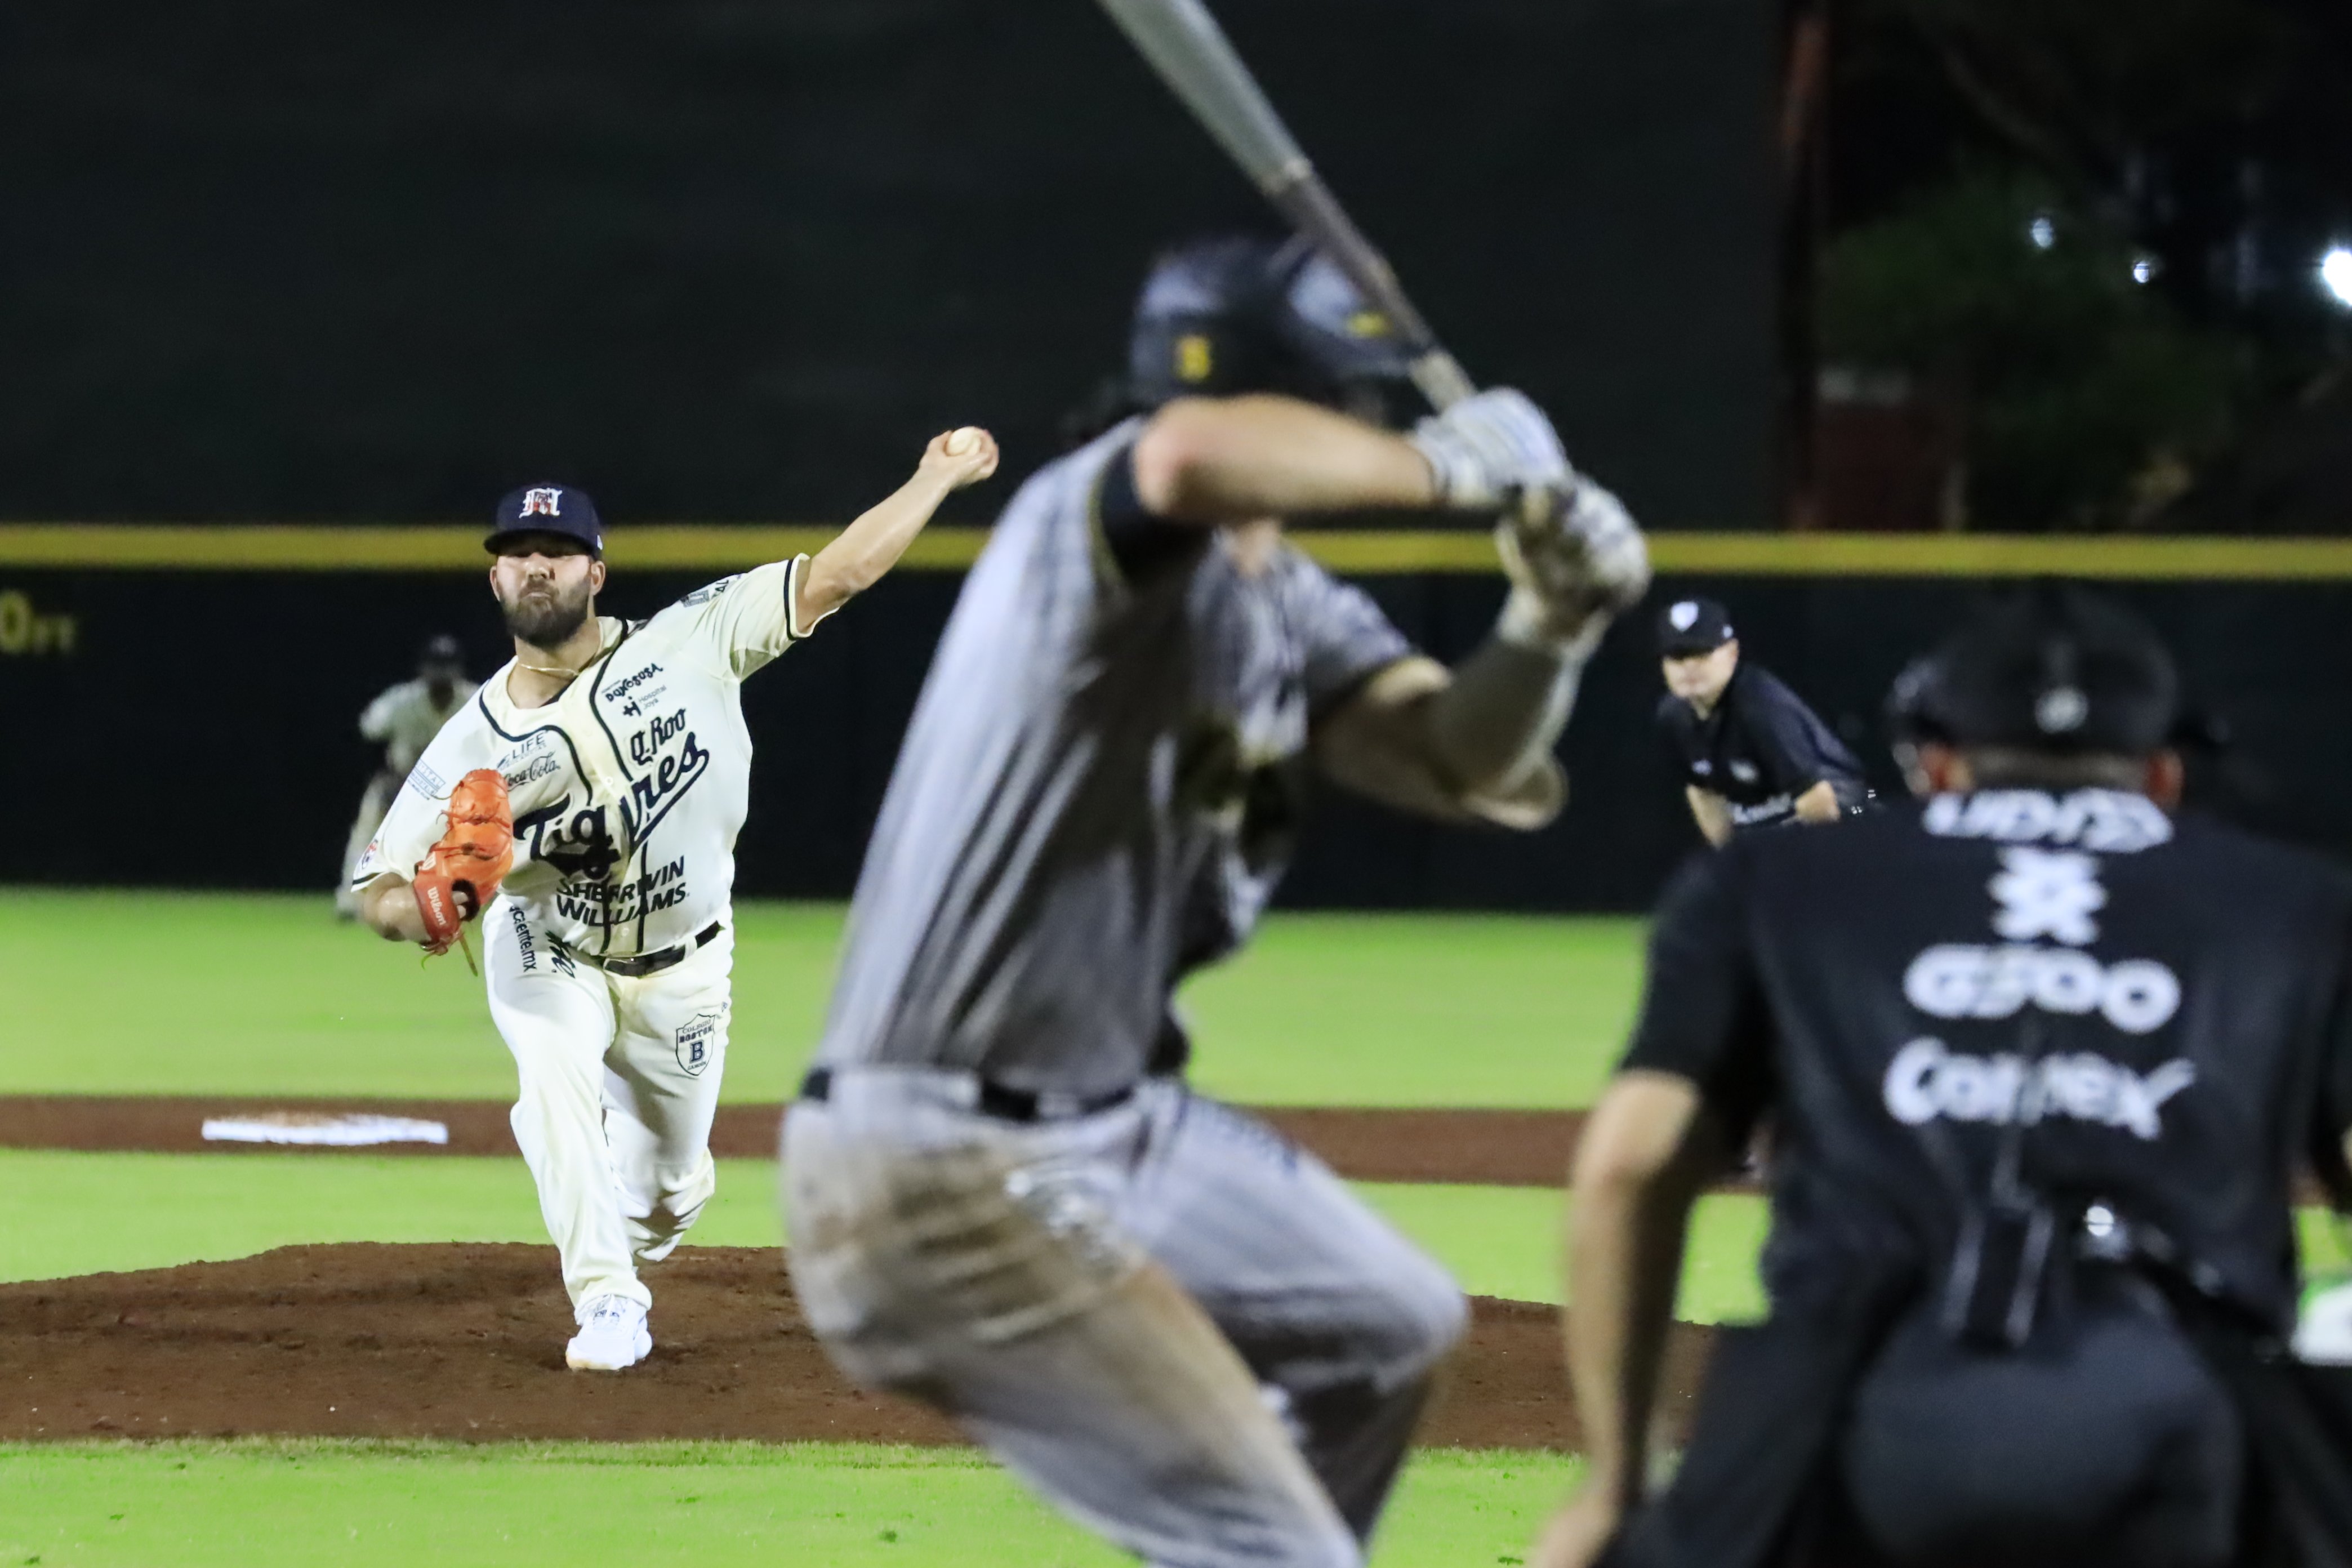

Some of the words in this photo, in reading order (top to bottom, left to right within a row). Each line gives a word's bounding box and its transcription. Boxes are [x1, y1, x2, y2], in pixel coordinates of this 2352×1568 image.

[638, 685, 667, 703] Hospital
[513, 732, 546, 759] LIFE
[427, 886, 447, 926] Wilson
[679, 1024, 713, 1043] BOSTON
[682, 1019, 711, 1034] COLEGIO
[689, 1039, 705, 1064] B
